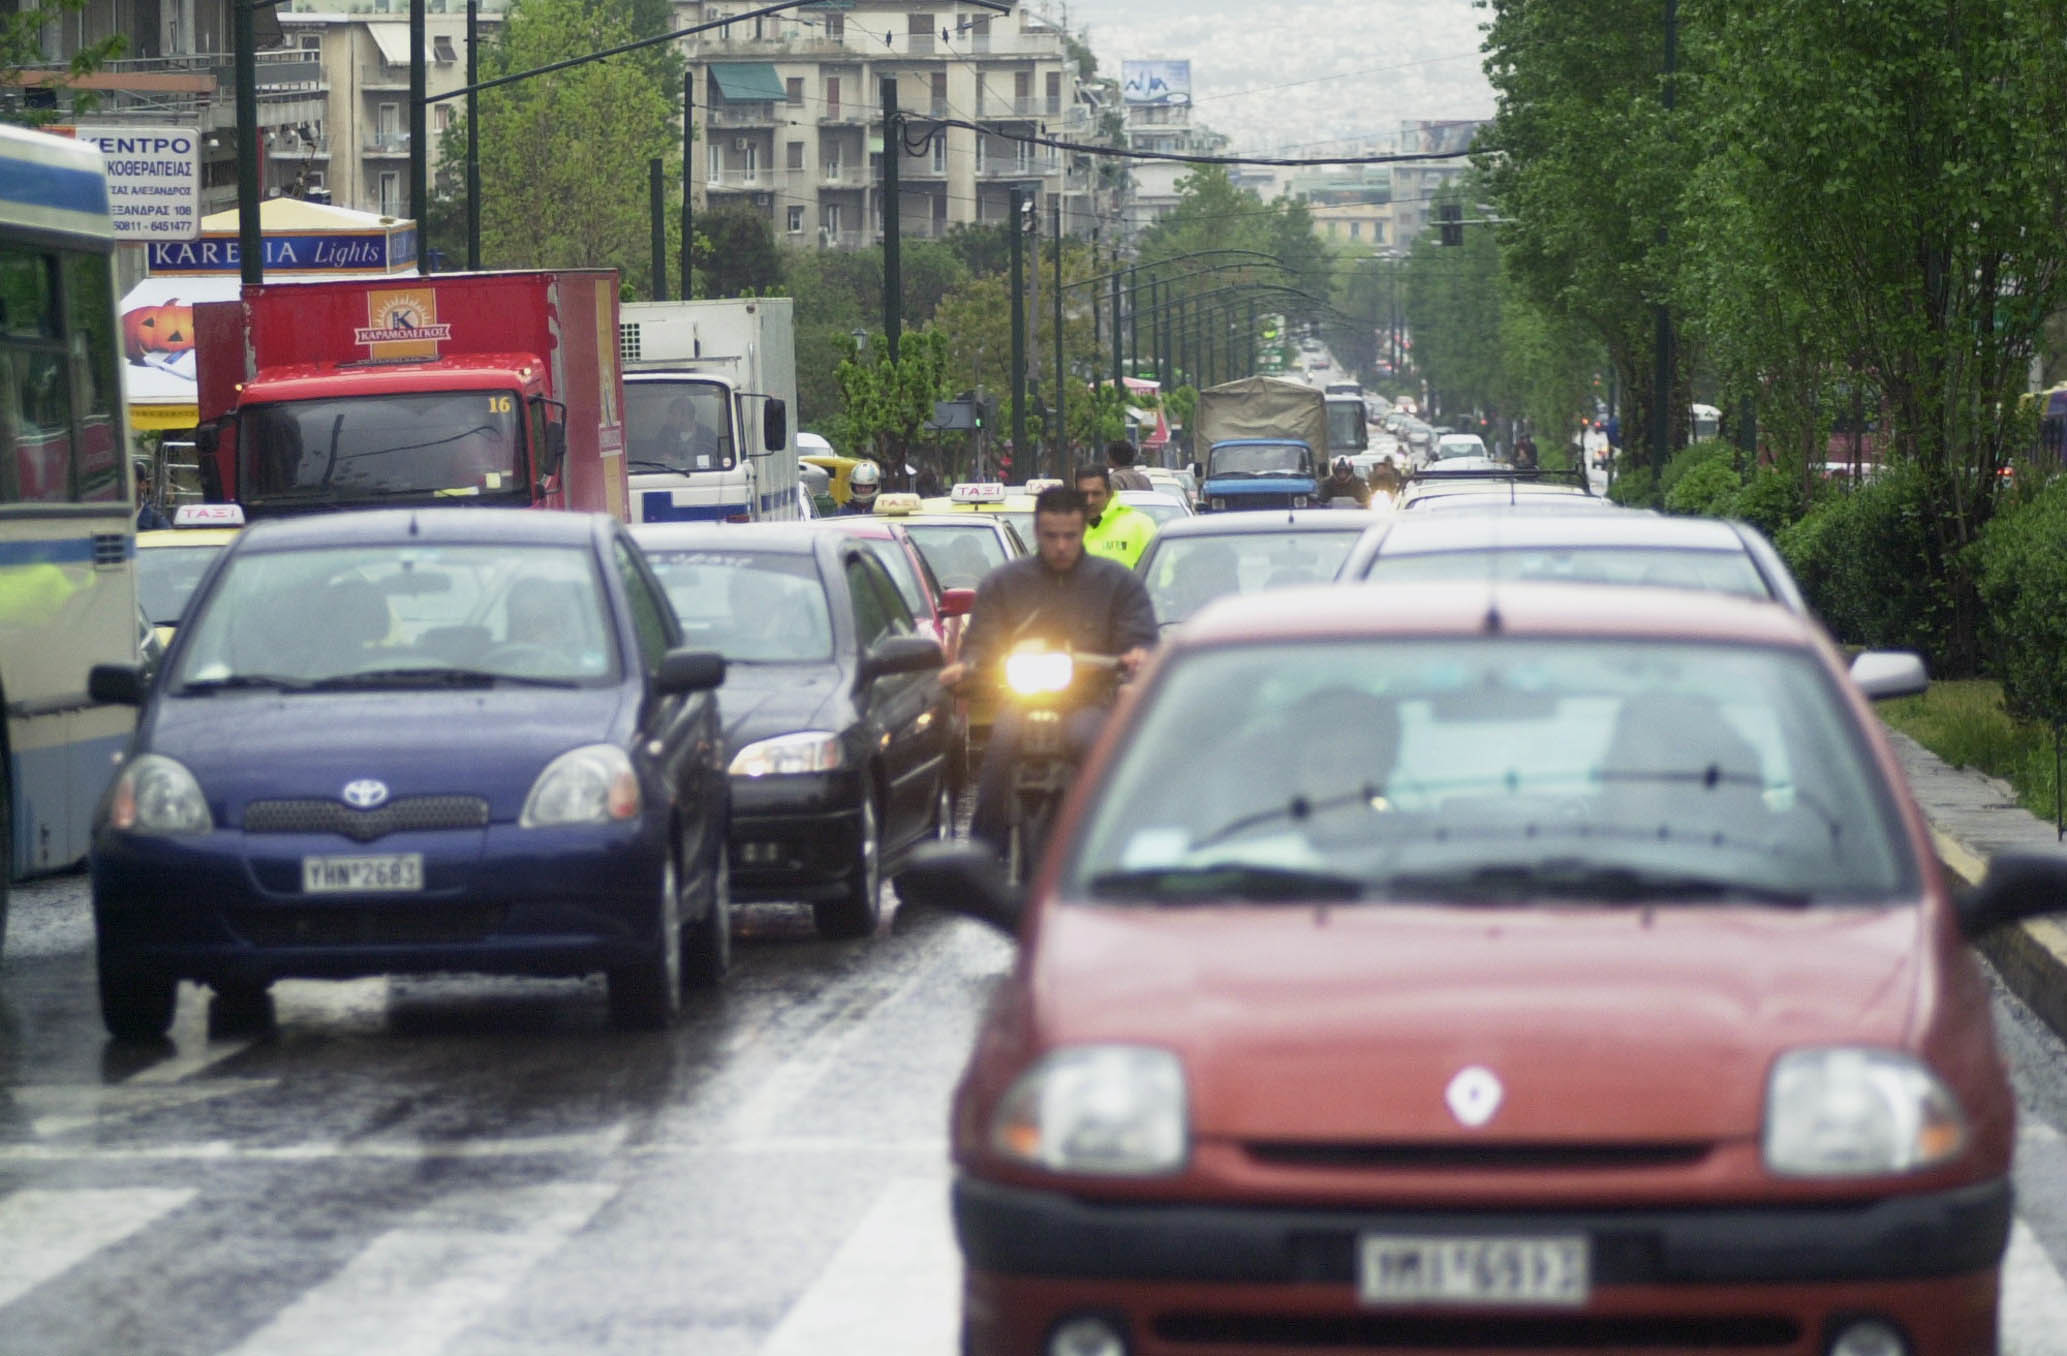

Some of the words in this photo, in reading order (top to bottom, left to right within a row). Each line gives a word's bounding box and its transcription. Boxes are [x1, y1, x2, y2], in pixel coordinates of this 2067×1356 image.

[86, 138, 191, 153] ΕΝΤΡΟ
[151, 221, 192, 231] 6451477
[155, 241, 298, 264] KAREIA
[314, 240, 380, 267] Lights
[488, 396, 511, 414] 16
[959, 486, 1001, 497] ΤΑΞΙ
[184, 508, 236, 519] ΤΑΞΙ
